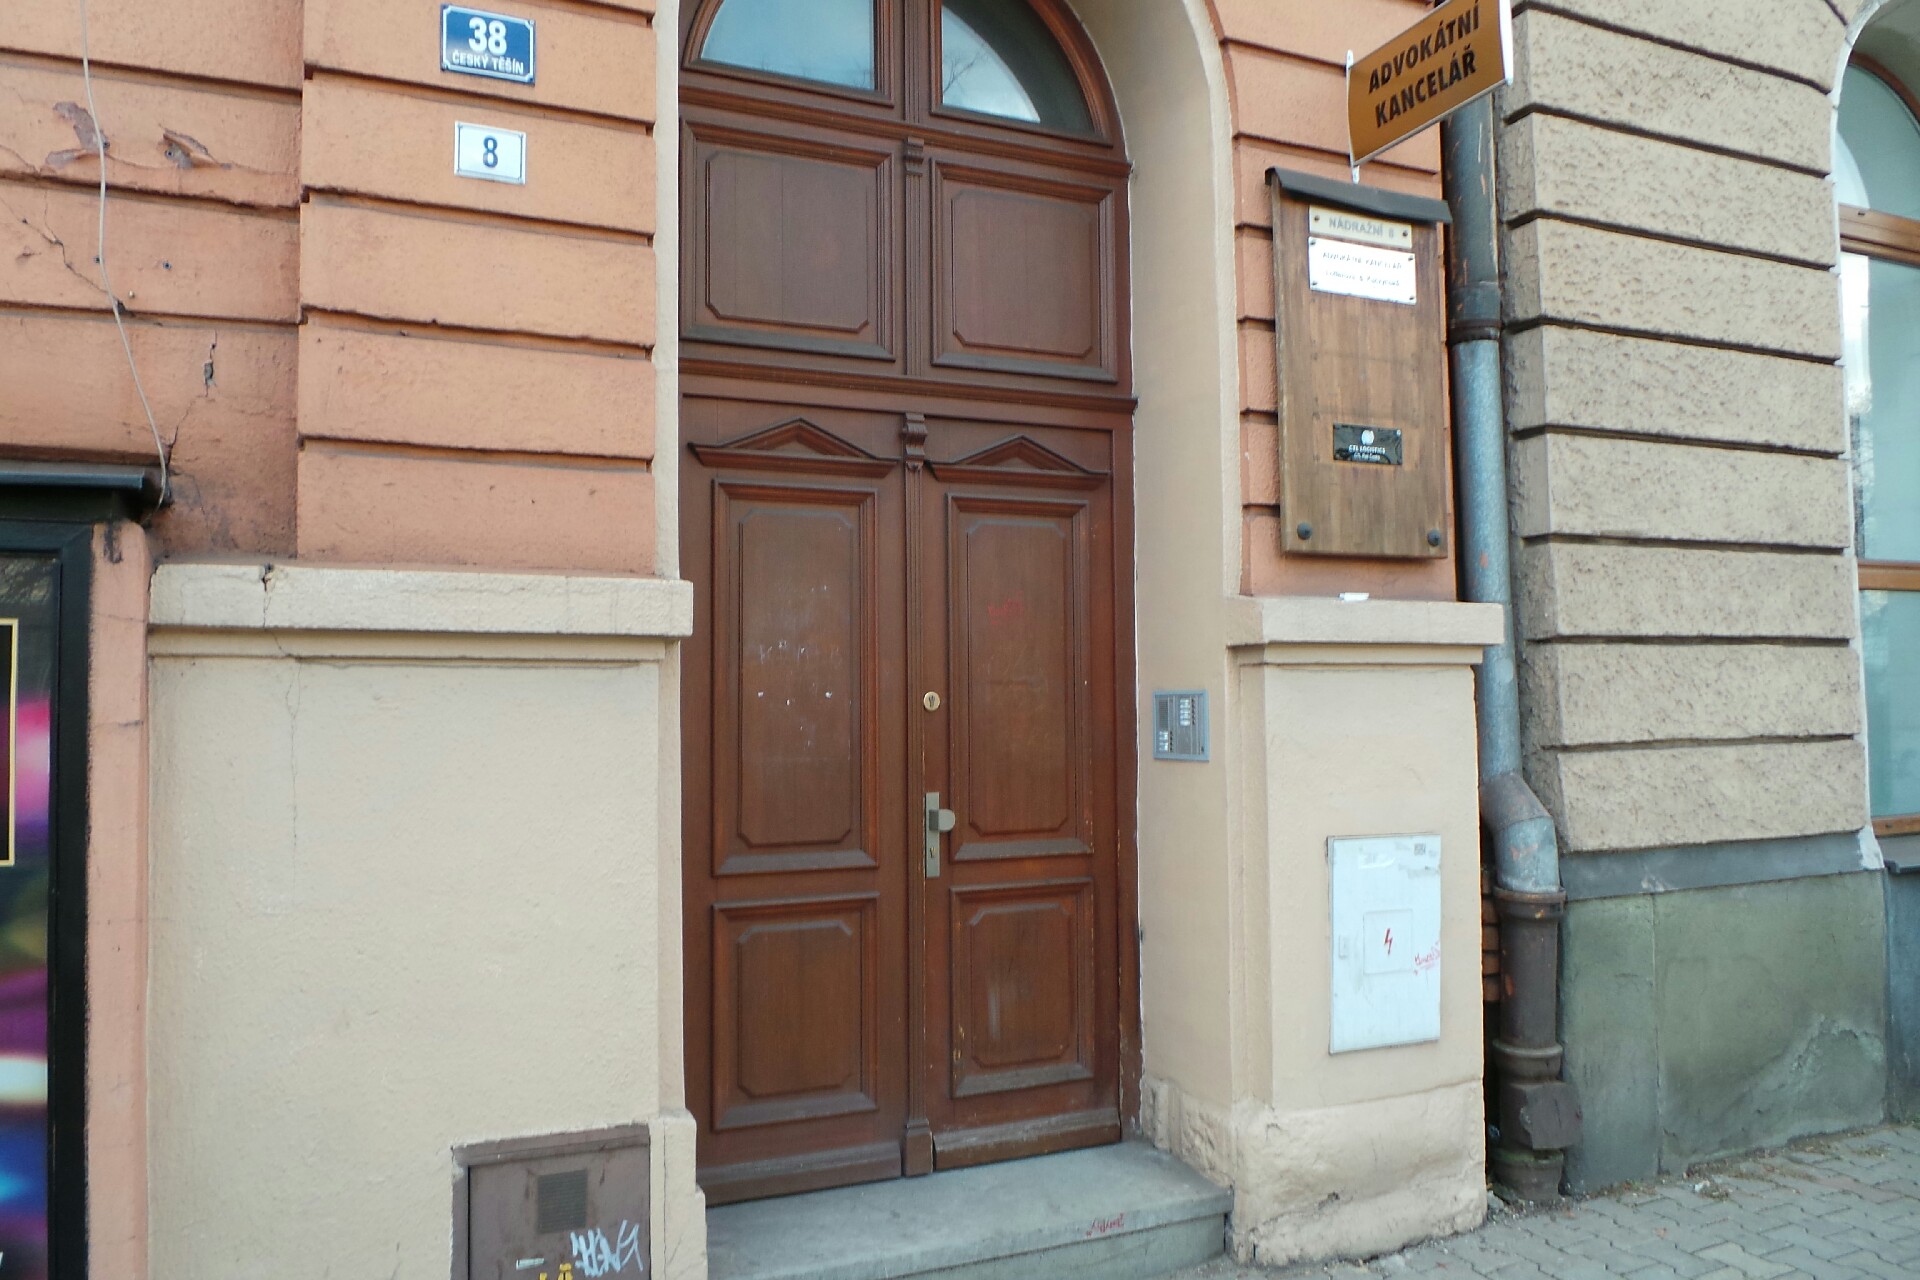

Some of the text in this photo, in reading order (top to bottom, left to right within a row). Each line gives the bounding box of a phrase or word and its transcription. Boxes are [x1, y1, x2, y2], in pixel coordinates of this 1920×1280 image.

[468, 17, 507, 56] 38
[1369, 0, 1480, 94] ADVOKÁTNÍ
[452, 50, 524, 75] ČESKÝ TĚŠÍN
[1374, 43, 1476, 128] KANCELÁŘ
[483, 135, 498, 168] 8
[1328, 215, 1383, 237] NÁDRAŽNÍ
